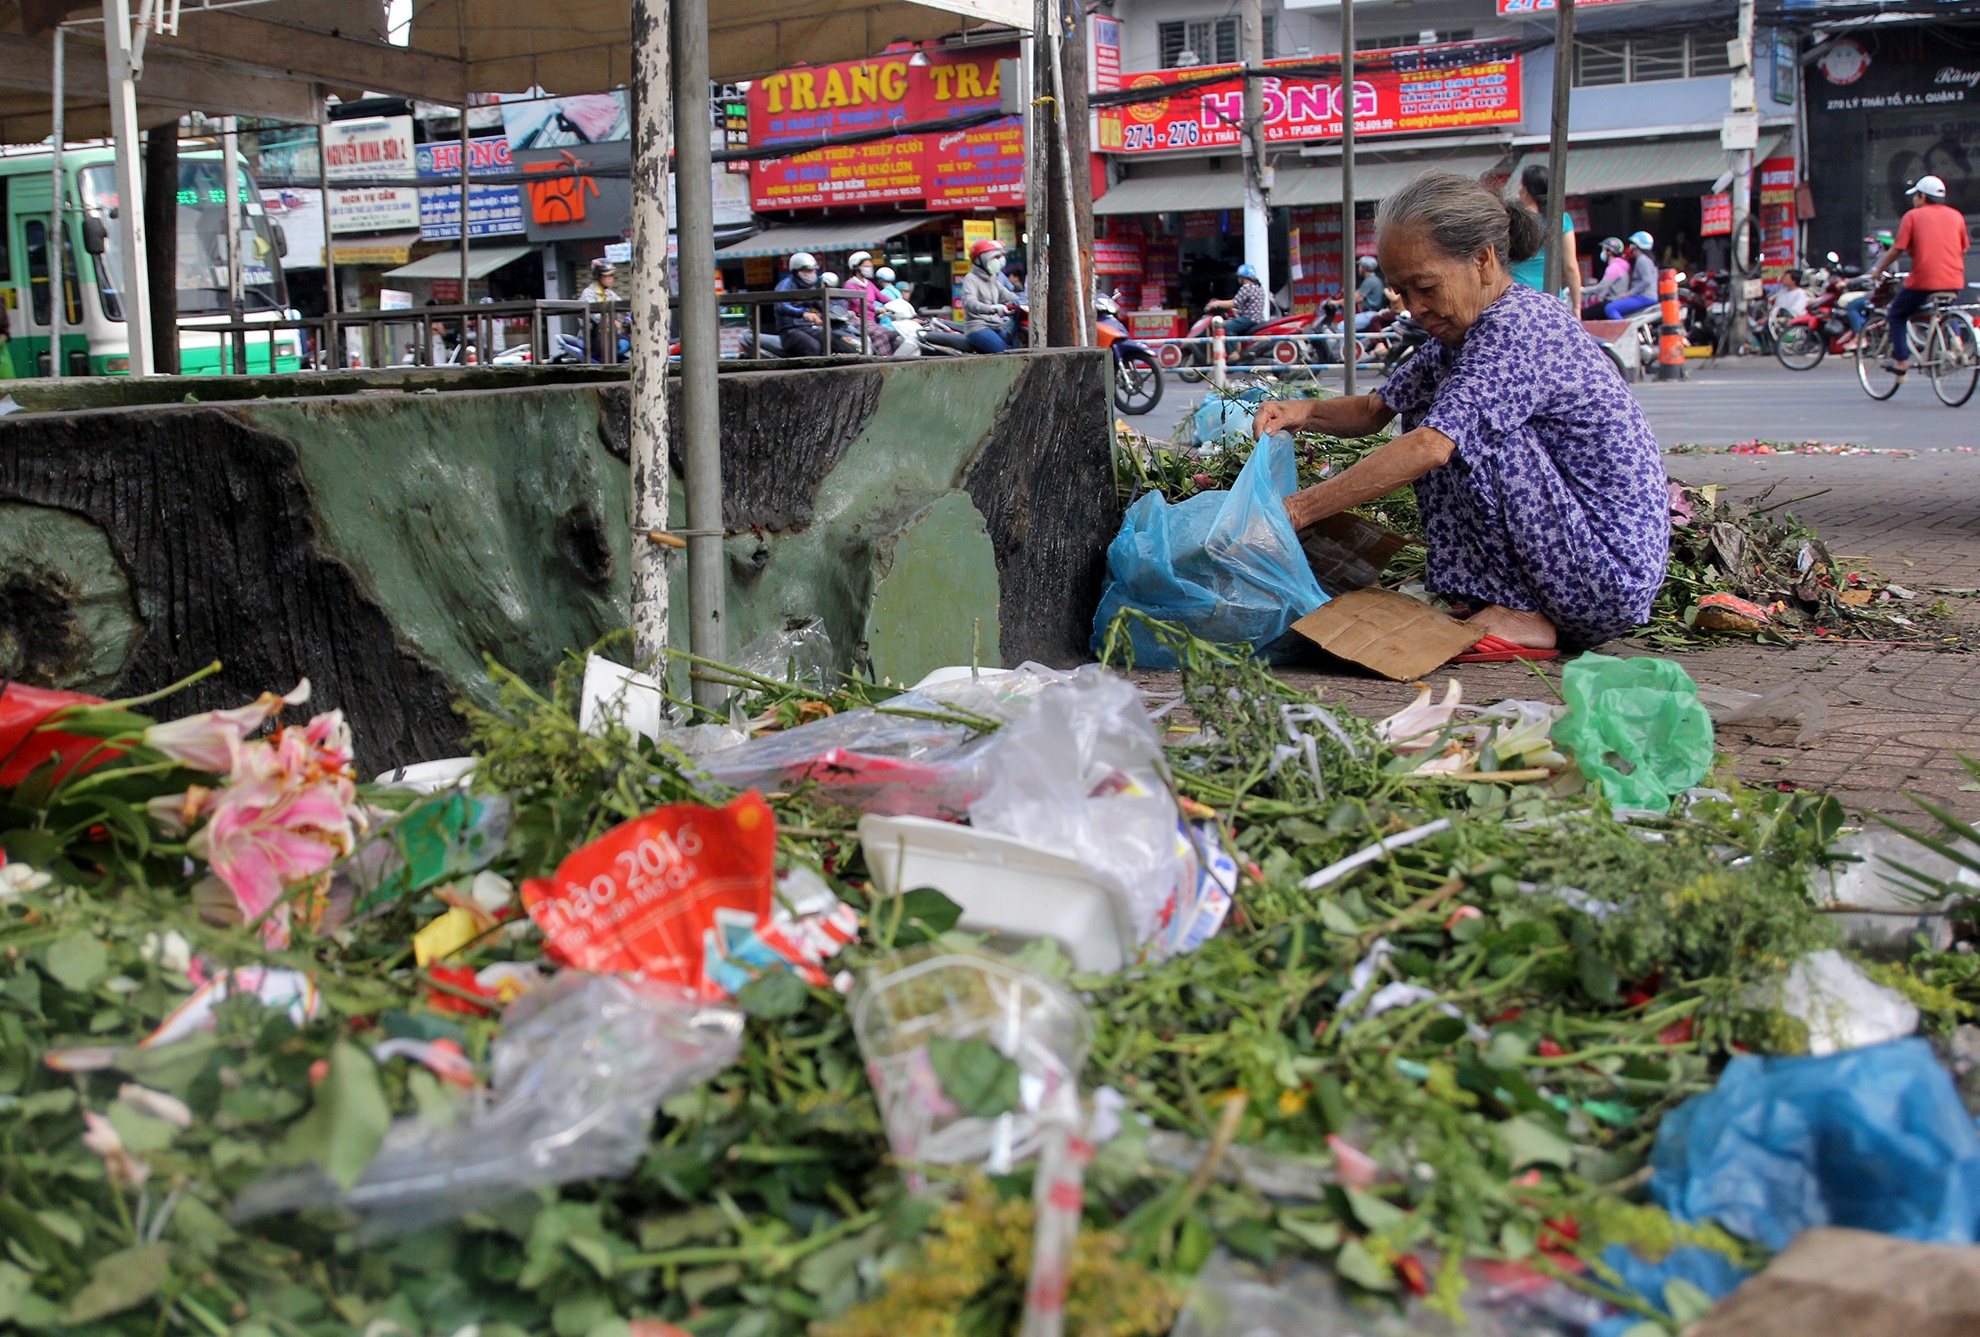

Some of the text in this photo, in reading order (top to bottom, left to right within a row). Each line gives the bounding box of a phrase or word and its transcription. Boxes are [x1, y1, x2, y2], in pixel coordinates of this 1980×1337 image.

[761, 61, 909, 114] TRANG
[1124, 123, 1155, 149] 274
[1168, 120, 1199, 147] 276
[615, 822, 703, 891] 2016
